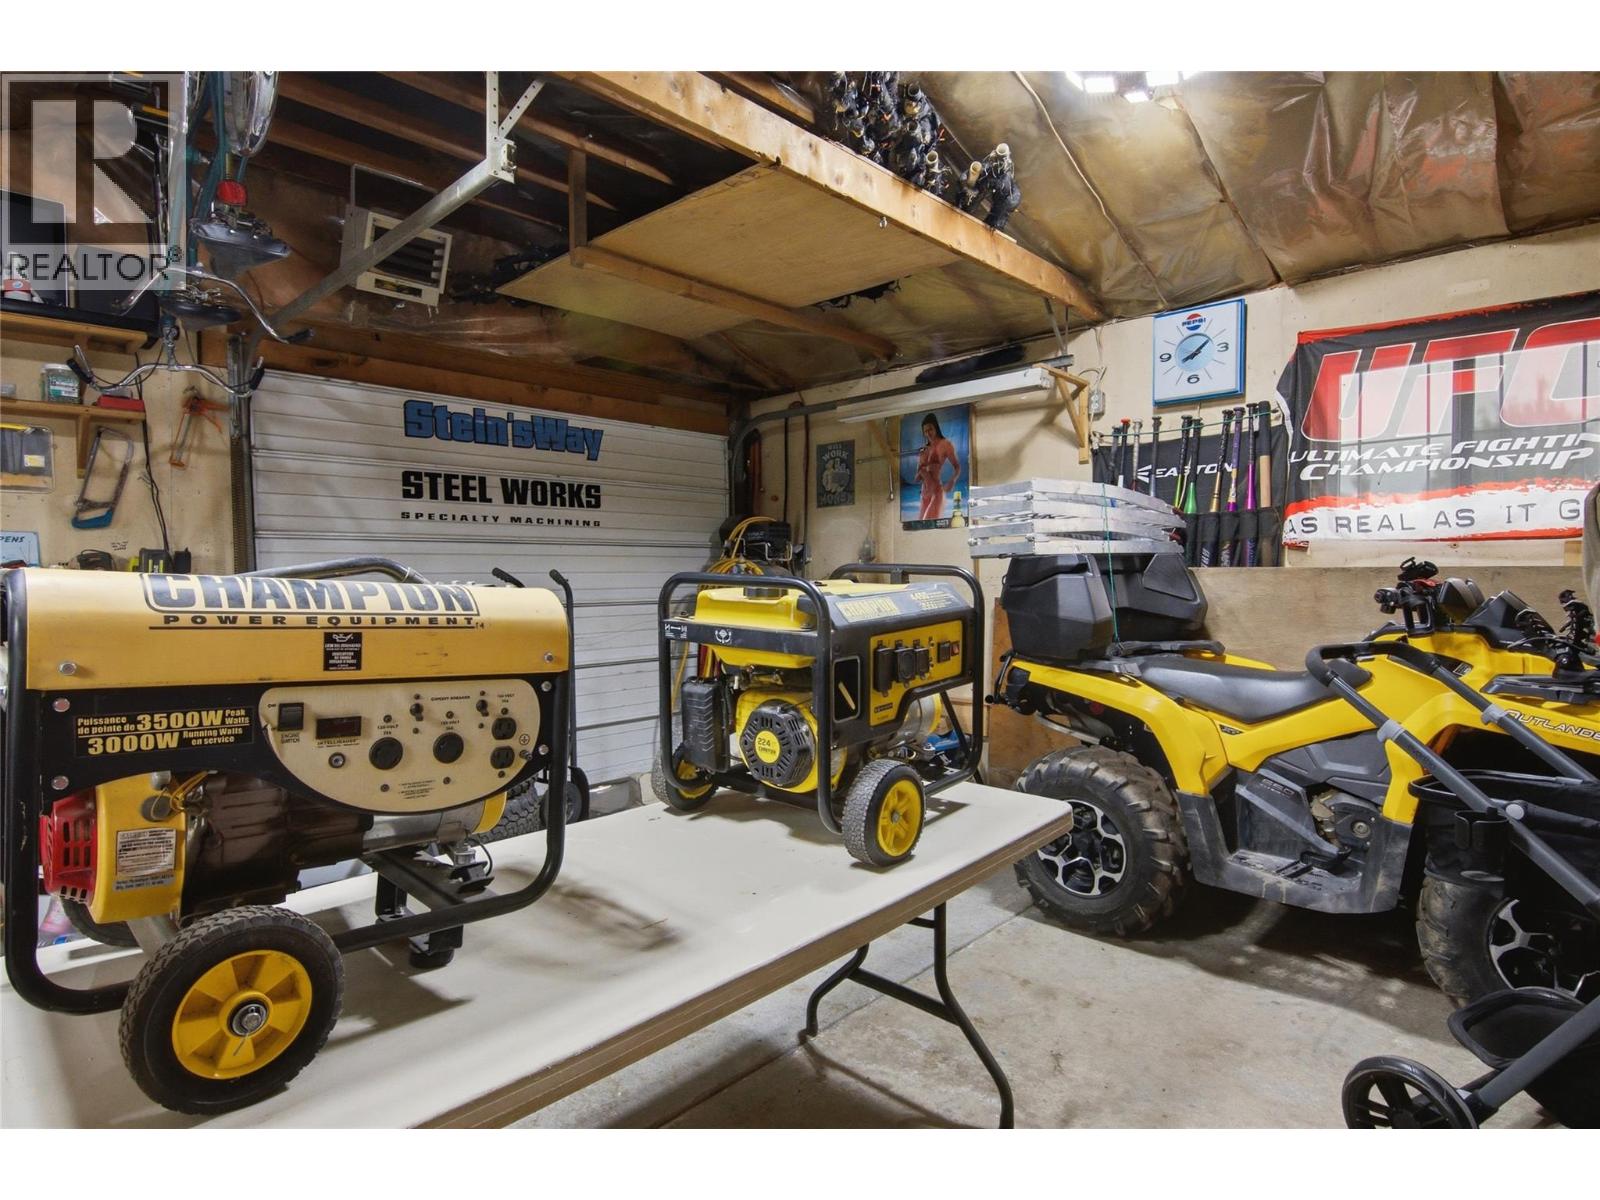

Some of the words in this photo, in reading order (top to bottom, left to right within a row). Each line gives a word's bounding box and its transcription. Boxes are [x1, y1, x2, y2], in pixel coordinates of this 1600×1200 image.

[1182, 318, 1206, 326] PEPSI
[1217, 342, 1229, 352] 3
[1160, 353, 1172, 362] 9
[1187, 374, 1200, 384] 6
[1301, 316, 1600, 442] UFC
[1290, 442, 1443, 463] ULTIMATE
[1300, 447, 1594, 481] CHAMPIONSHIP
[402, 470, 493, 503] STEEL
[500, 478, 601, 508] WORKS
[401, 512, 499, 522] SPECIALTY
[510, 516, 601, 527] MACHINING
[1334, 513, 1416, 534] REAL
[1433, 508, 1476, 528] AS
[1506, 503, 1537, 524] IT
[151, 574, 474, 611] CHAMPION
[163, 615, 287, 625] POWER
[306, 616, 475, 626] EQUIPMENT
[225, 709, 245, 717] Peak
[77, 717, 127, 726] Puissance
[136, 710, 223, 731] 3500W
[225, 716, 250, 725] Watts
[78, 727, 90, 735] de
[91, 724, 122, 735] pointe
[123, 723, 135, 732] de
[183, 729, 218, 739] Running
[219, 727, 243, 736] Watts
[88, 732, 179, 755] 3000W
[191, 738, 202, 746] en
[204, 736, 235, 745] service
